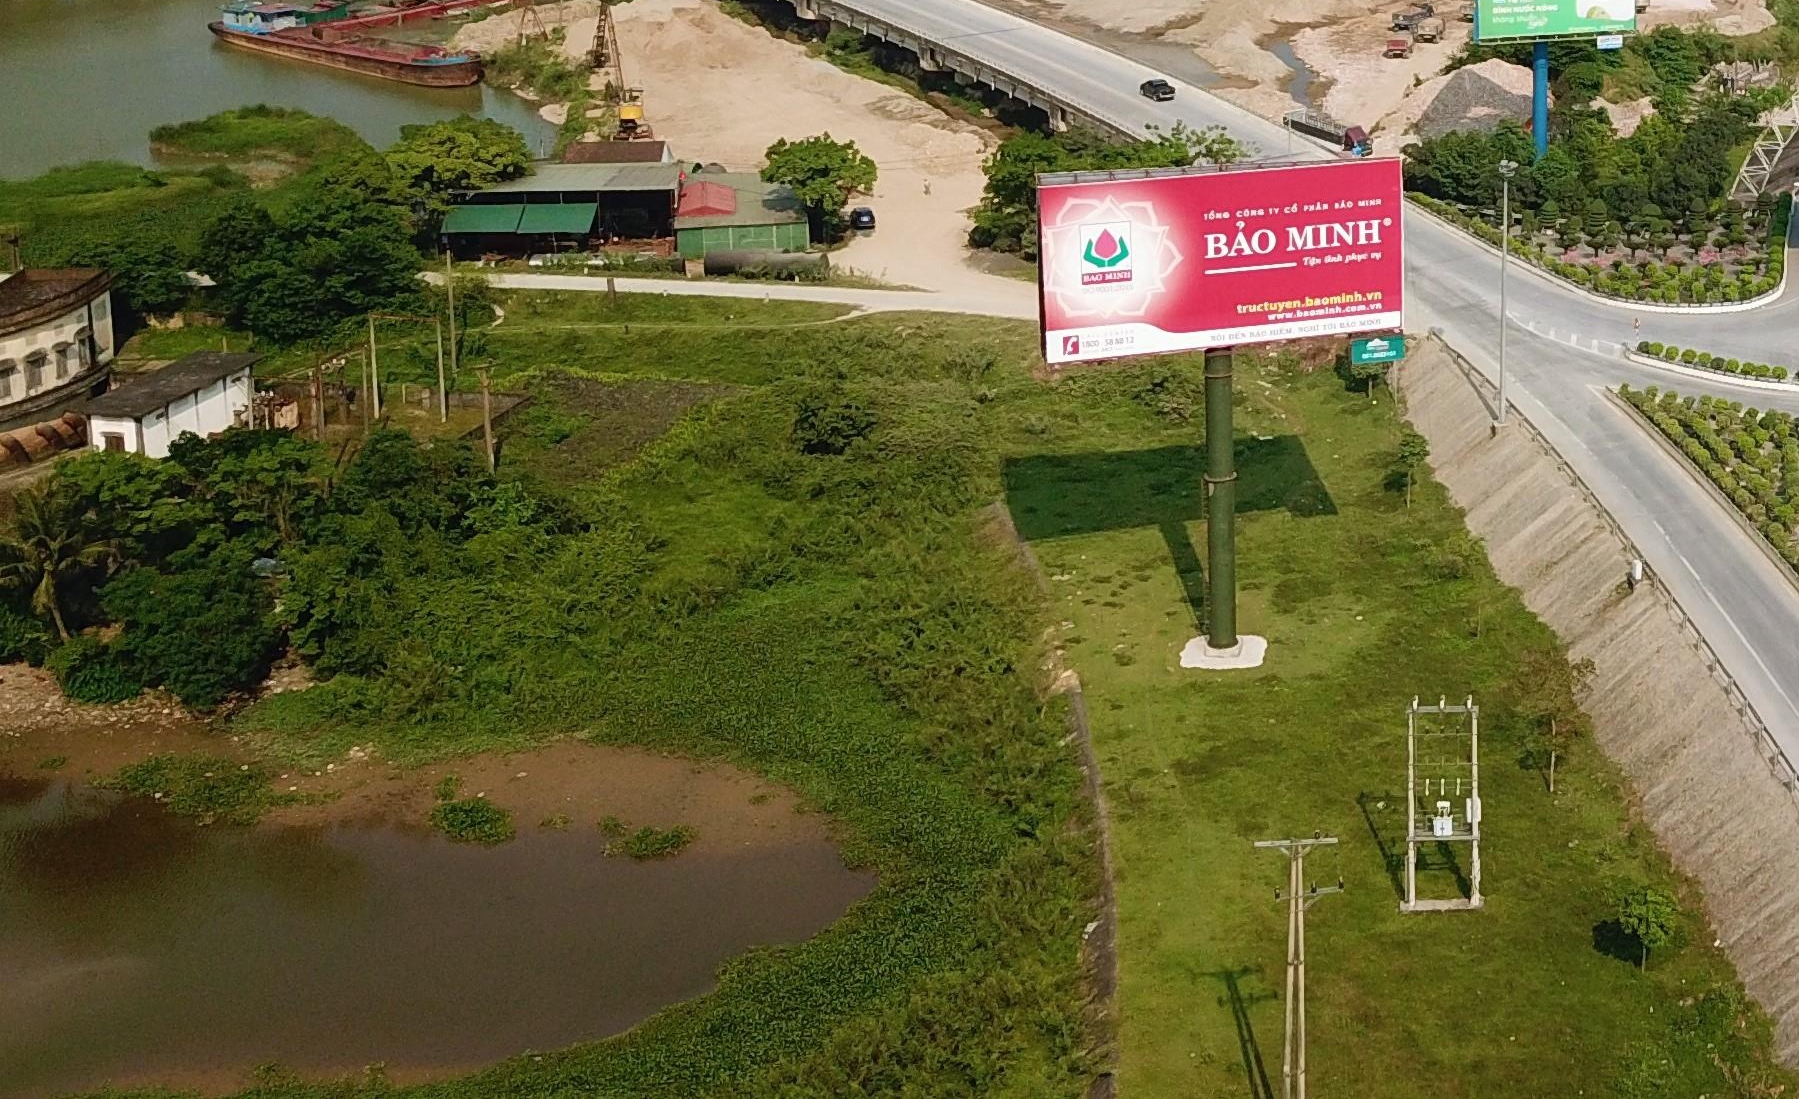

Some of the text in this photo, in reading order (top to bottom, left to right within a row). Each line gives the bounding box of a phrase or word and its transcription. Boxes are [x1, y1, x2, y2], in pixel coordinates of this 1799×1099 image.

[1204, 220, 1277, 259] BẢO
[1236, 290, 1382, 314] tructuyen.baominh.vn
[1267, 302, 1382, 320] www.baominh.com.vn
